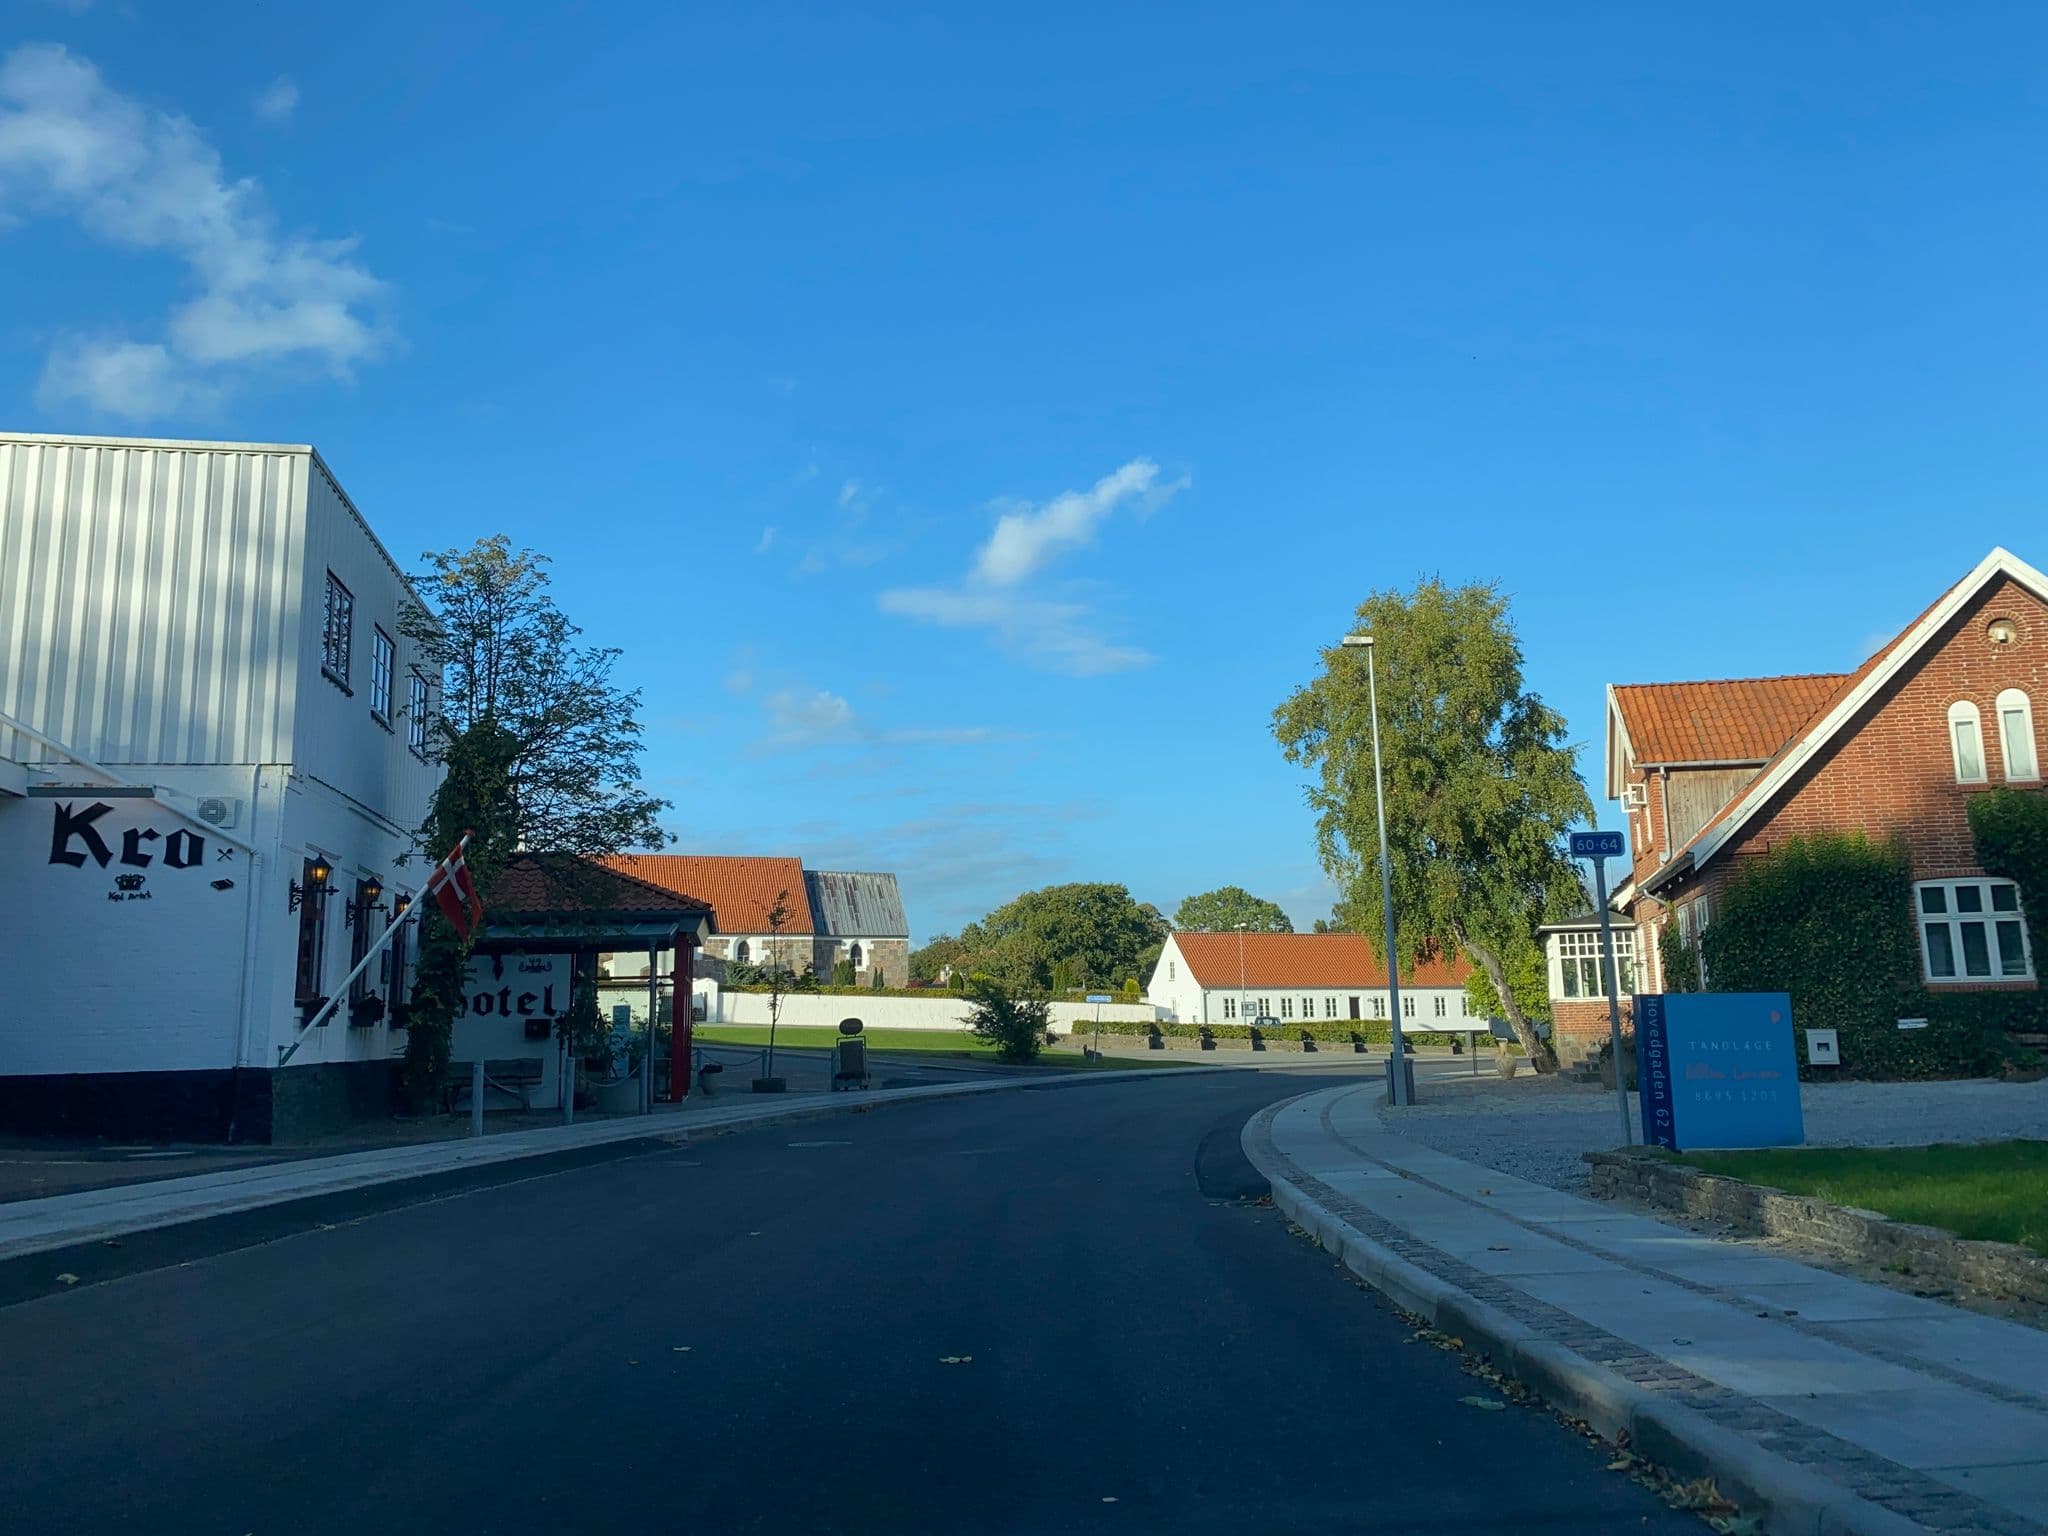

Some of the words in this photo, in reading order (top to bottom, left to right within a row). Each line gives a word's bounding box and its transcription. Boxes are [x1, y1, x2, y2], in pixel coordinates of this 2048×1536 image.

[48, 800, 206, 870] Kro
[1577, 839, 1618, 850] 60-64
[1648, 998, 1665, 1100] Hovedgaden
[1656, 1108, 1669, 1127] 62
